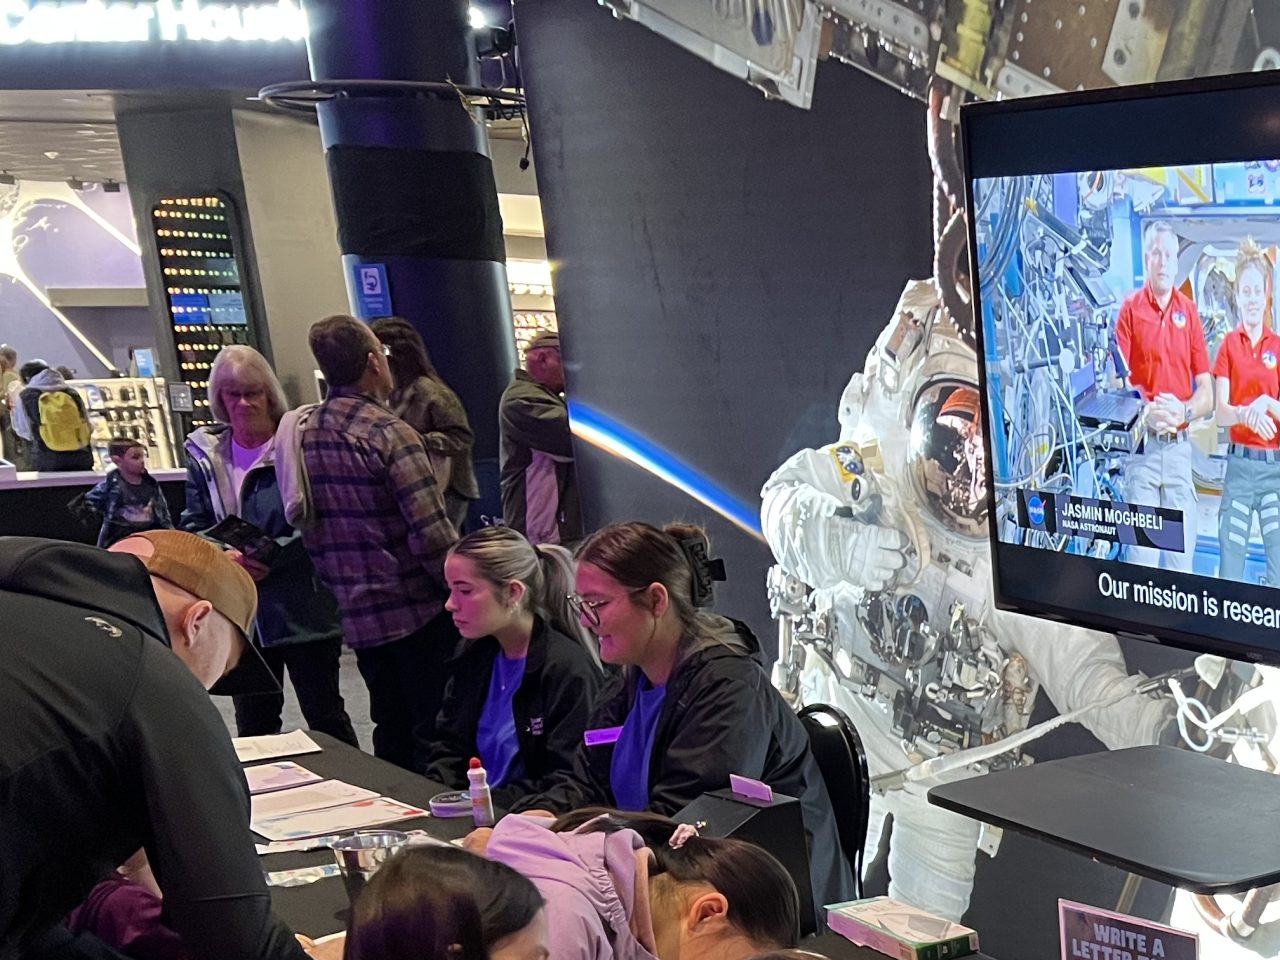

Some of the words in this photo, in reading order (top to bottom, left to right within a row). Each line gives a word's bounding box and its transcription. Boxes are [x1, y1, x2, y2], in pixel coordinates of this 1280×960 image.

[1061, 503, 1103, 522] JASMIN
[1104, 508, 1163, 530] MOGHBELI
[1062, 520, 1079, 530] NASA
[1080, 523, 1117, 536] ASTRONAUT
[1098, 573, 1129, 600] Our
[1133, 579, 1199, 614] mission
[1203, 592, 1219, 617] is
[1093, 923, 1147, 953] WRITE
[1152, 938, 1165, 957] A
